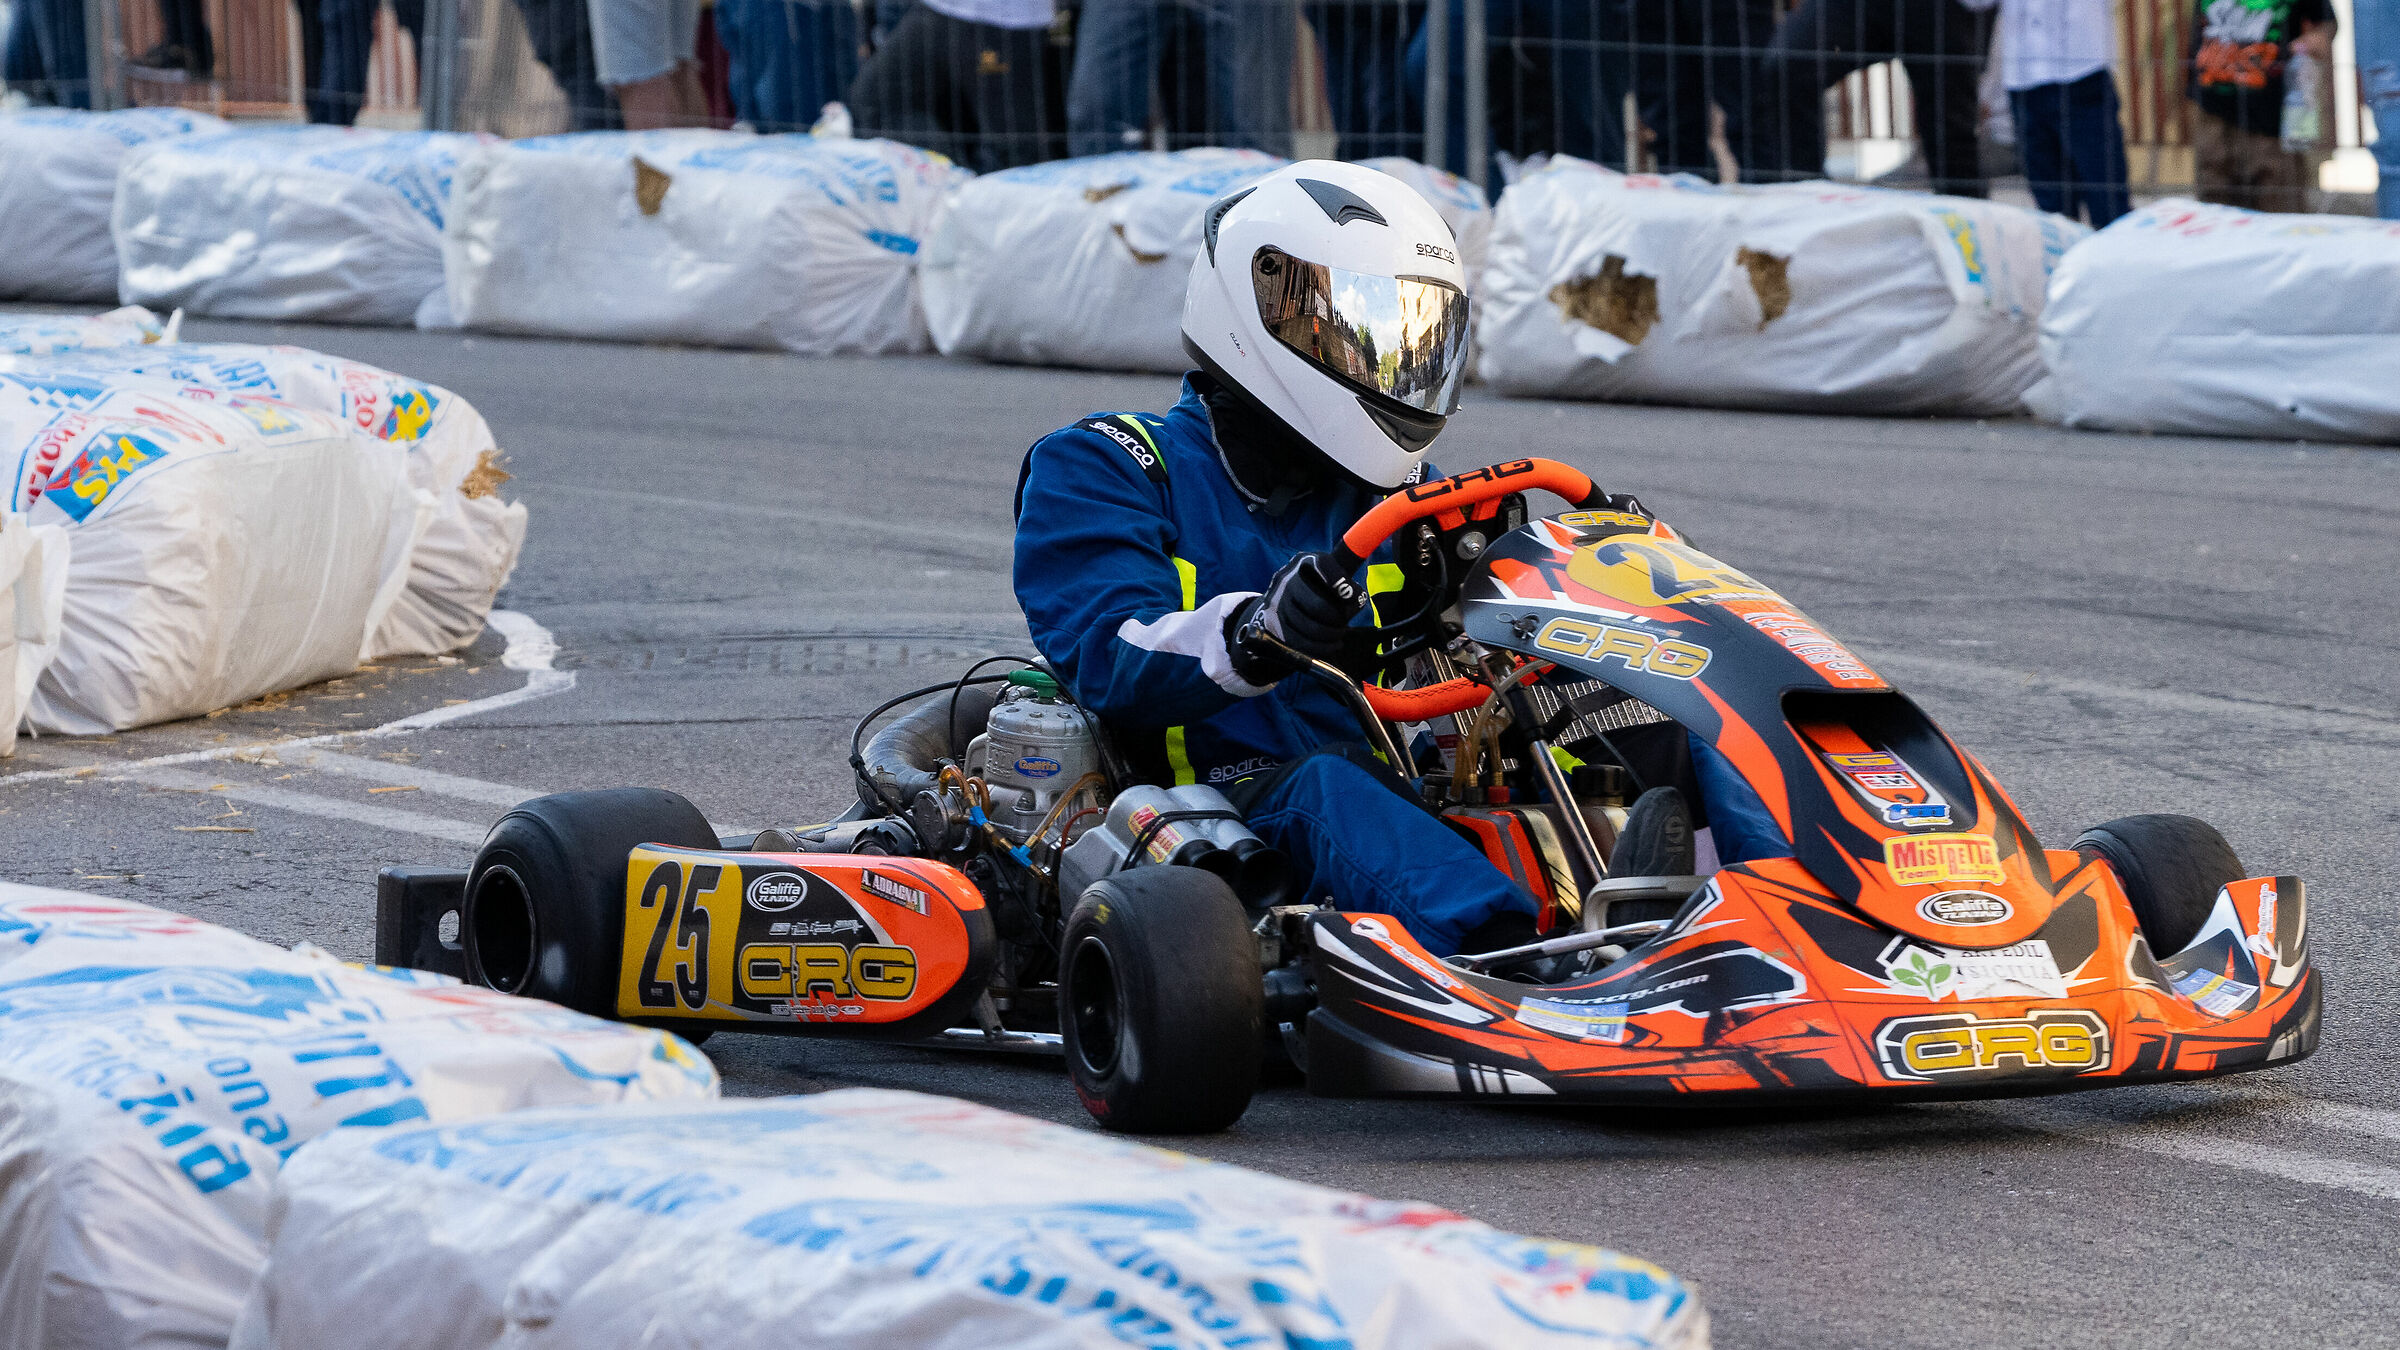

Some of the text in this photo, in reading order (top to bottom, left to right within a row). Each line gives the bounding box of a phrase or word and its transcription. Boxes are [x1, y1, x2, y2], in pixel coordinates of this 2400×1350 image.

[1415, 242, 1455, 264] sparco
[1089, 421, 1155, 470] sparco
[1406, 458, 1535, 502] CRG
[1558, 511, 1651, 527] CRG
[1534, 617, 1714, 681] CRG
[758, 881, 802, 895] Galiffa
[1898, 869, 1939, 880] Team
[1933, 899, 2005, 913] Galiffa
[638, 860, 723, 1011] 25
[739, 942, 918, 1002] CRG
[1901, 1023, 2097, 1074] CRG
